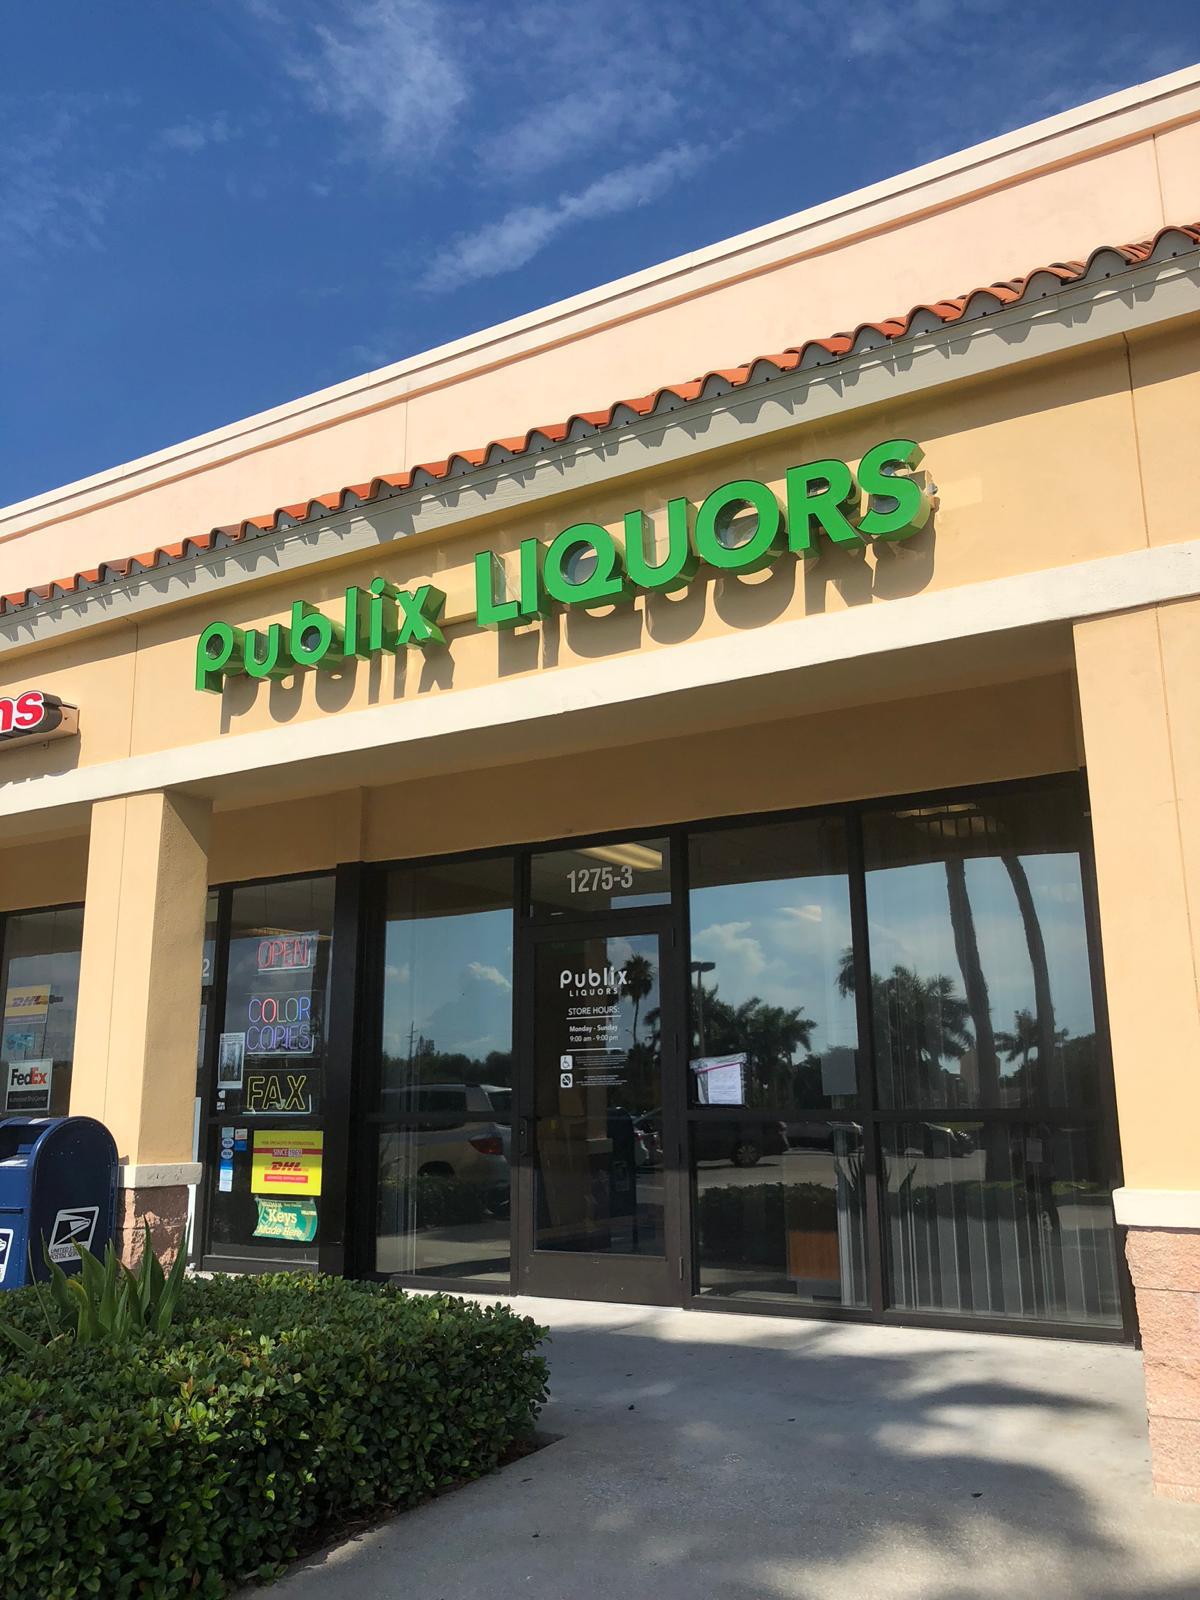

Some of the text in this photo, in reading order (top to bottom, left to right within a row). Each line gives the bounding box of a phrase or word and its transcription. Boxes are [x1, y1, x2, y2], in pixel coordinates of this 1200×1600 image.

[195, 439, 928, 692] Publix LIQUORS
[566, 864, 633, 894] 1275-3
[257, 936, 309, 969] OPEN
[560, 966, 628, 989] Publix
[569, 987, 619, 997] LIQUORS
[248, 996, 311, 1024] COLOR
[568, 1005, 621, 1016] STORE HOURS:
[246, 1024, 311, 1051] COPIES
[569, 1025, 593, 1033] Monday
[596, 1023, 619, 1032] Sunday
[569, 1035, 582, 1043] 9:00
[596, 1034, 608, 1042] 9:00
[609, 1034, 619, 1043] pm
[10, 1066, 48, 1087] FedEx
[246, 1074, 307, 1111] FAX
[271, 1161, 303, 1172] DHL
[268, 1207, 298, 1227] Keys
[255, 1224, 282, 1236] Made
